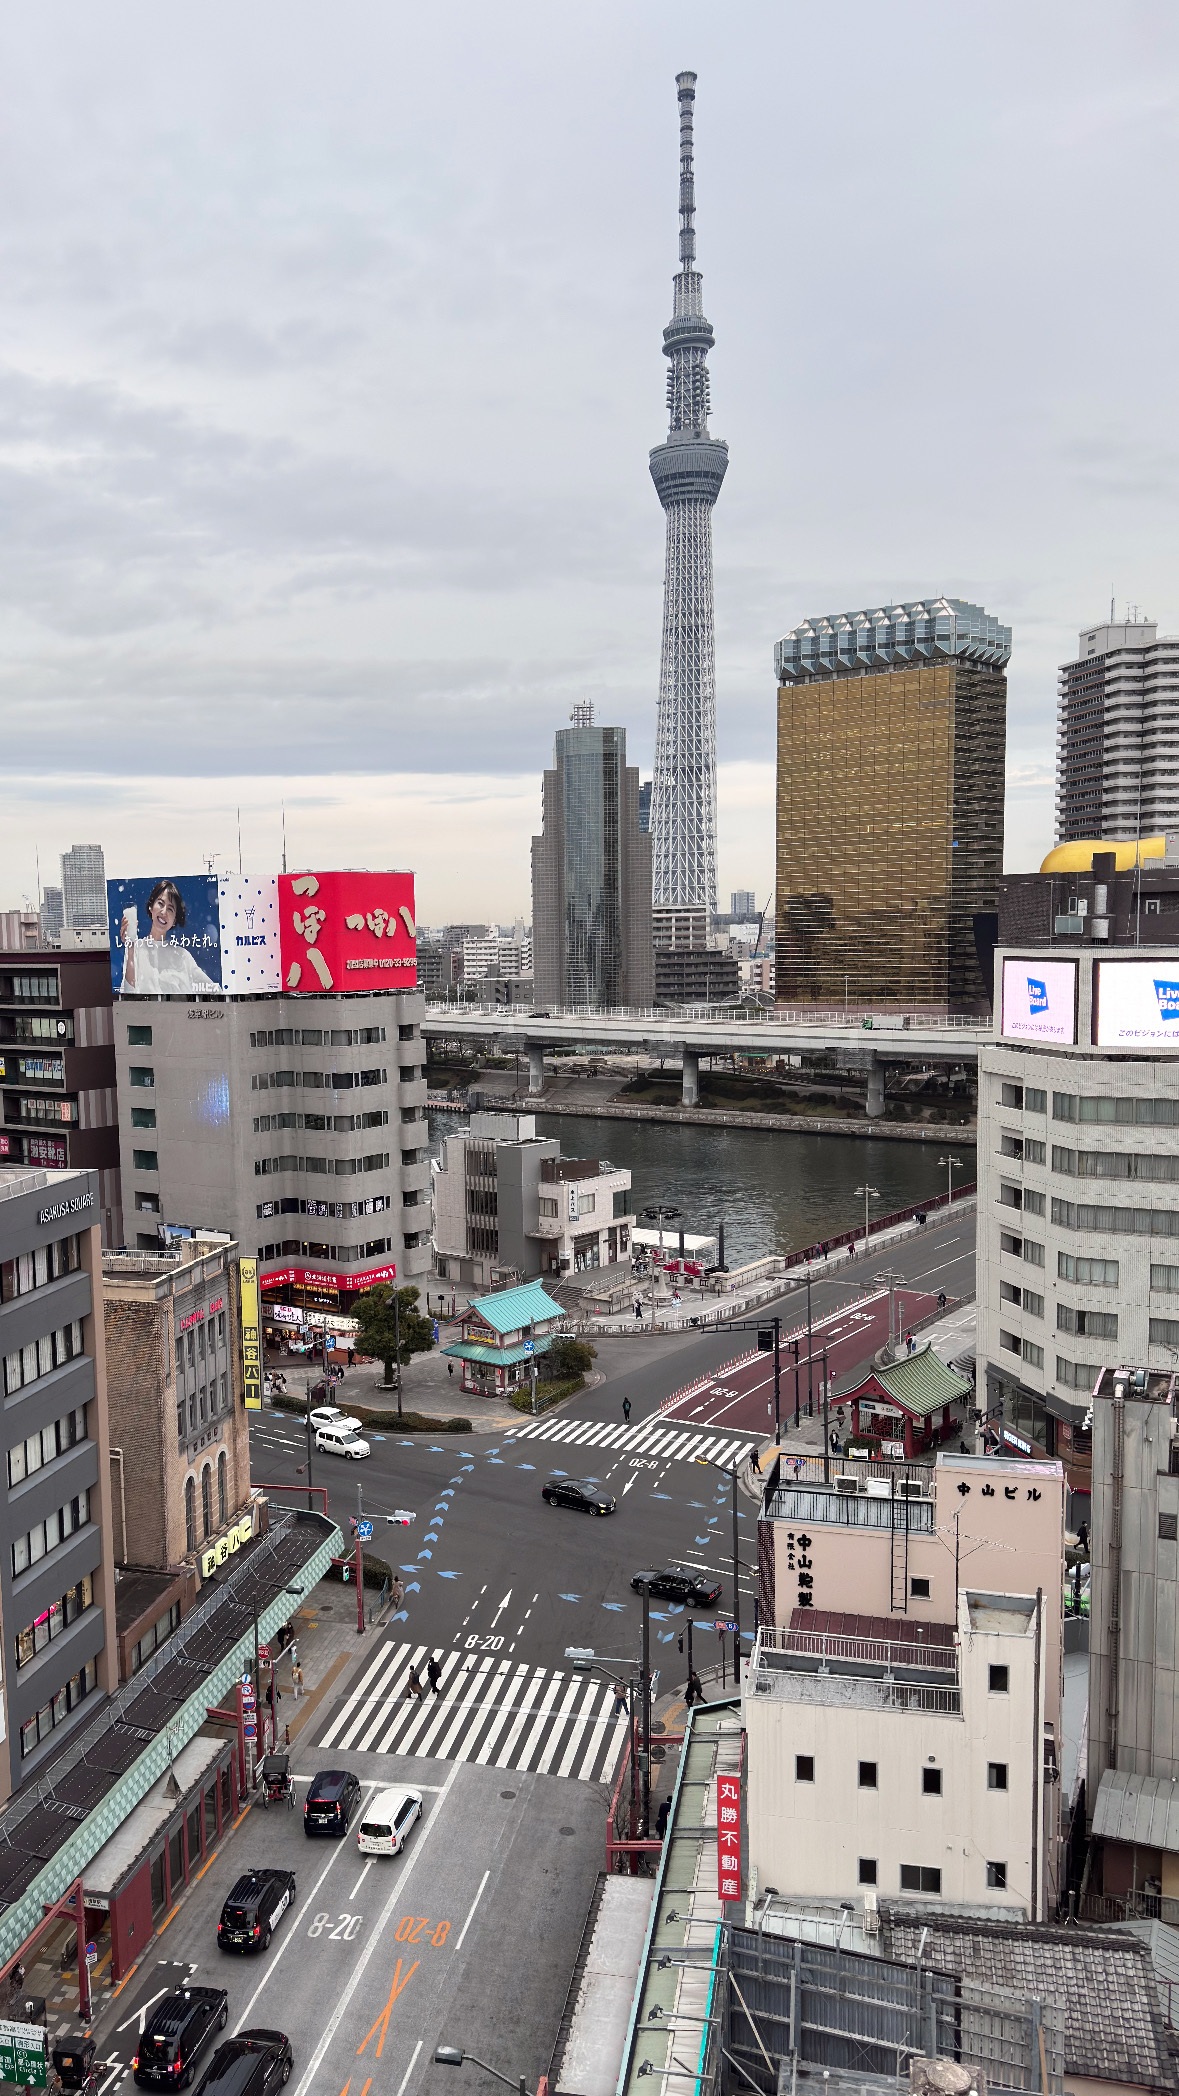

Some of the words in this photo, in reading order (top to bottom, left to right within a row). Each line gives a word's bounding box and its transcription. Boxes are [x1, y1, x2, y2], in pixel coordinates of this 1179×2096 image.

[345, 905, 416, 938] つぼ八
[115, 933, 218, 948] しあわせ、しみわたれ。
[236, 935, 267, 946] カルピス
[286, 876, 334, 990] つぼ八
[192, 982, 220, 992] カルピス
[1029, 985, 1042, 996] Live
[1158, 987, 1179, 999] Liv
[1030, 996, 1047, 1006] Board
[40, 1201, 70, 1225] ASAKUSA
[70, 1192, 95, 1213] SQUARE
[243, 1327, 260, 1399] 神谷バー
[628, 1457, 659, 1470] 8-20
[956, 1481, 1042, 1502] 中山ビル
[786, 1532, 796, 1571] 有限会社
[464, 1634, 505, 1650] 8-20
[720, 1782, 739, 1896] 丸勝不動産
[307, 1912, 363, 1941] 8-20
[394, 1915, 451, 1948] 8-20
[19, 2066, 37, 2075] Circle
